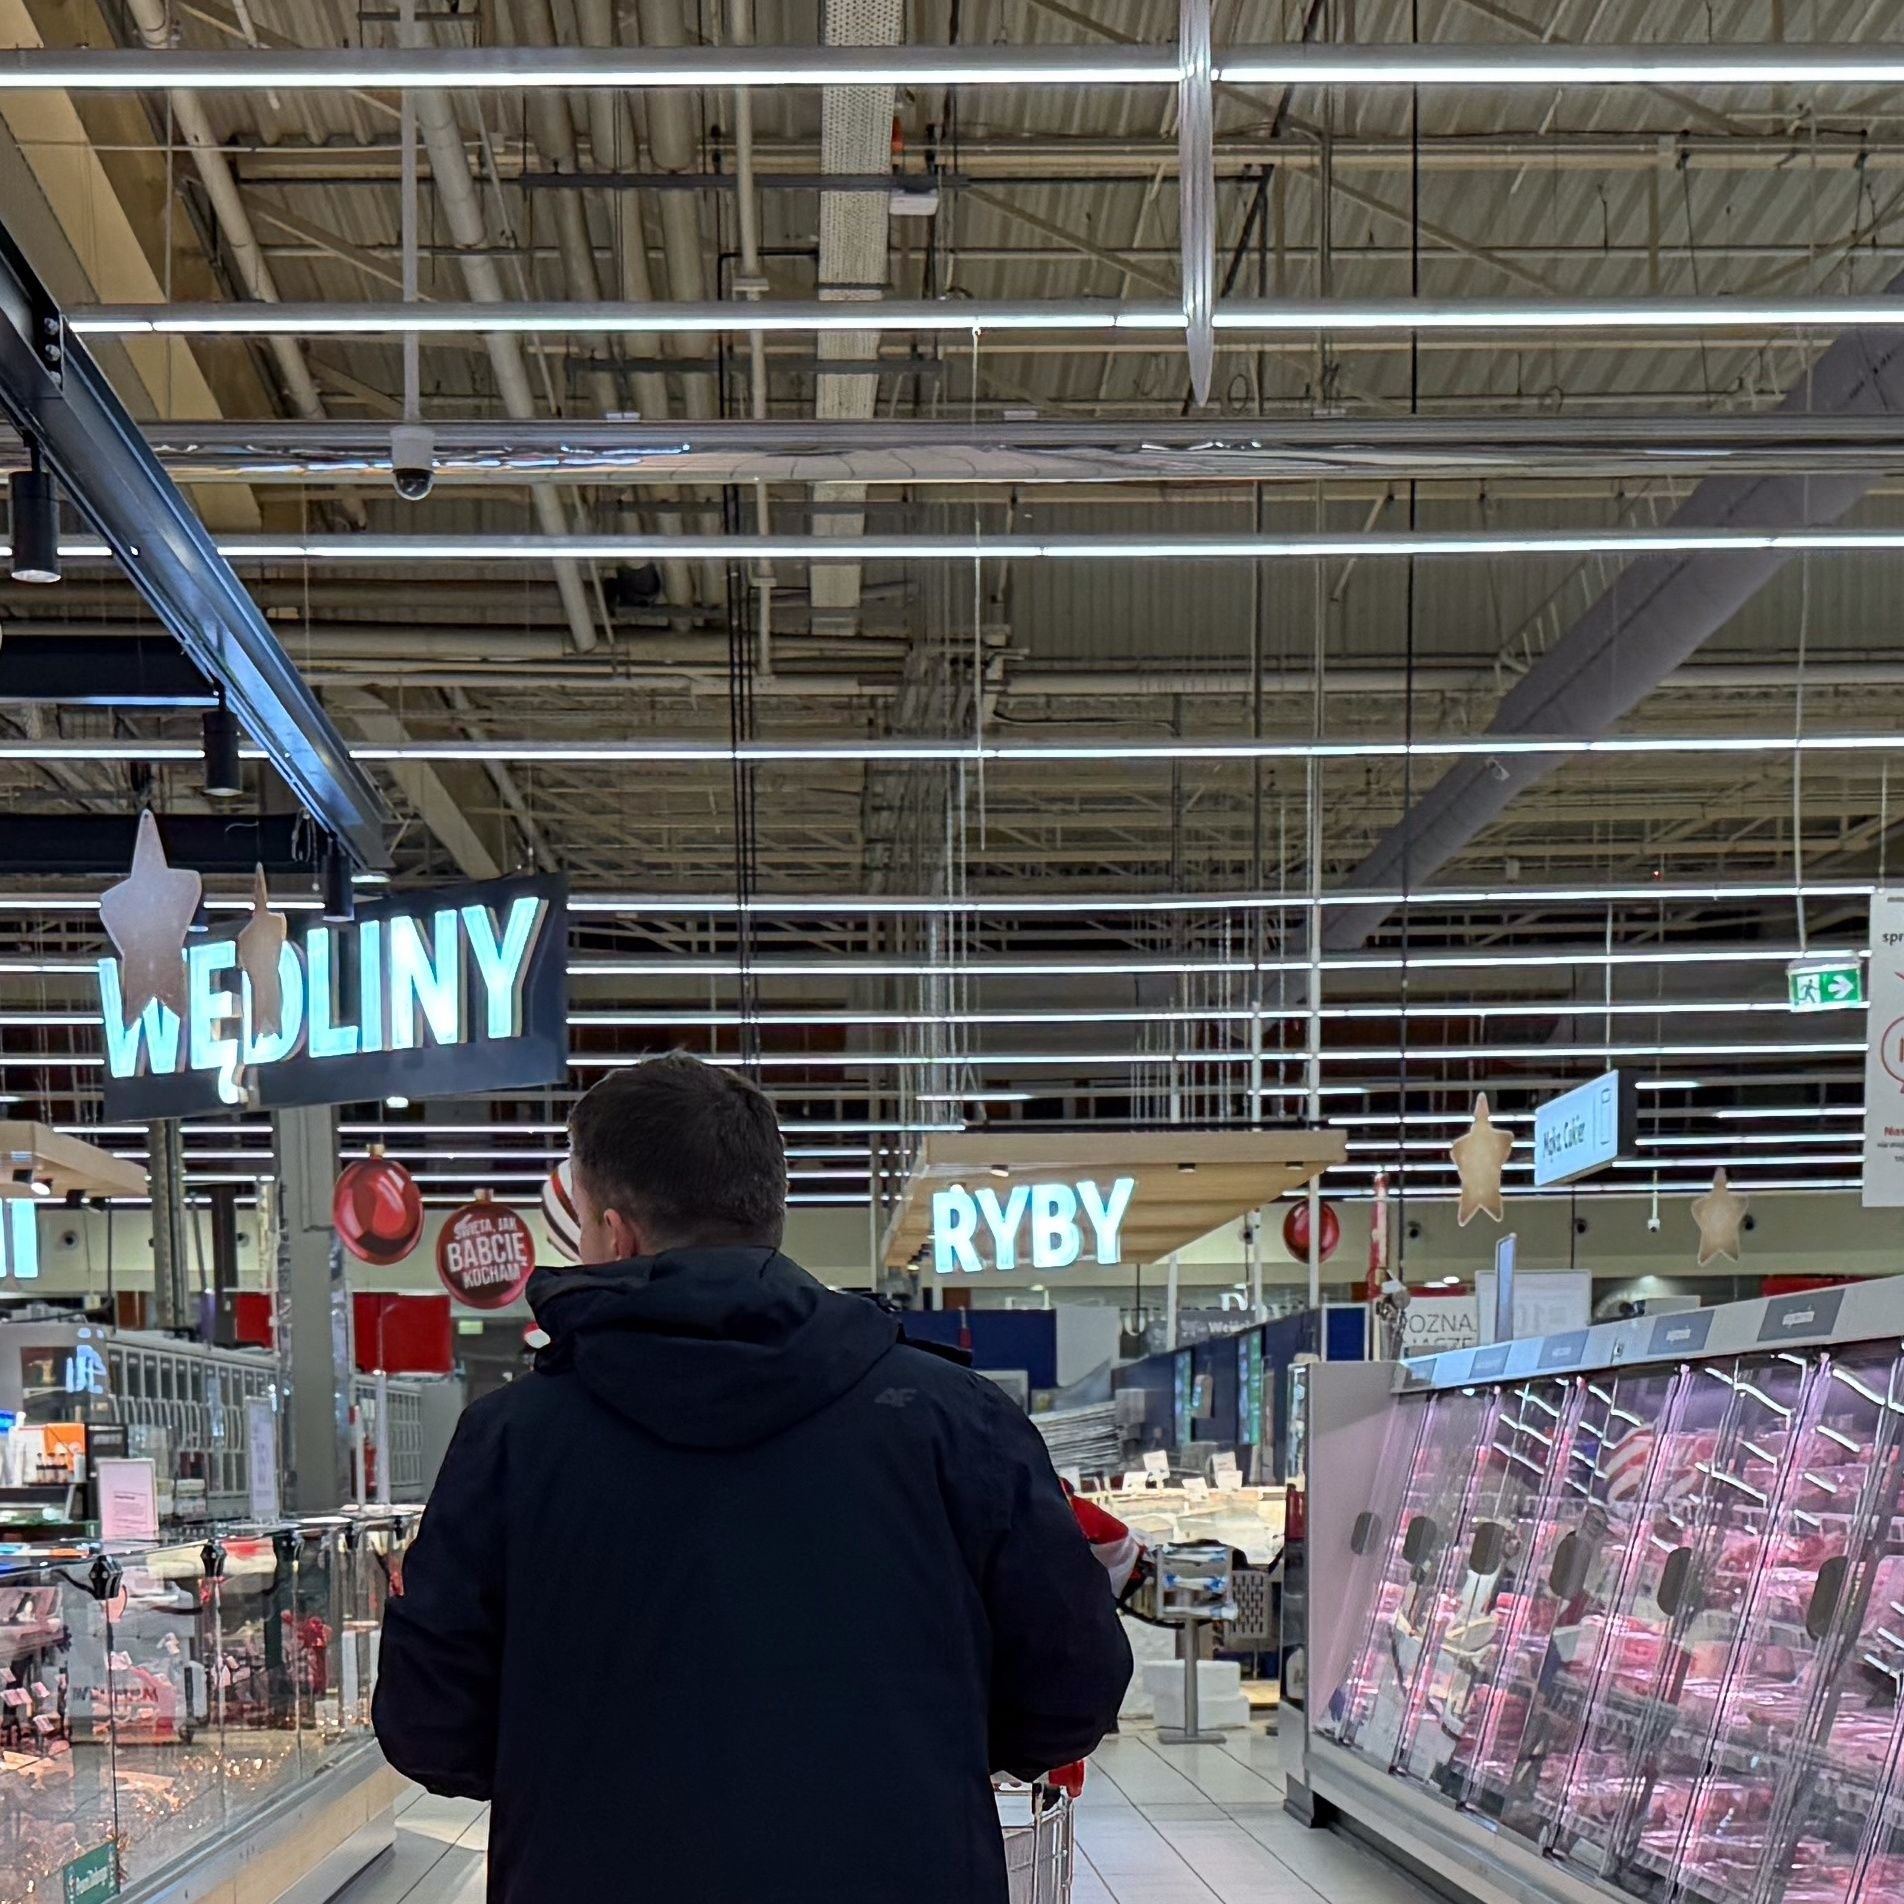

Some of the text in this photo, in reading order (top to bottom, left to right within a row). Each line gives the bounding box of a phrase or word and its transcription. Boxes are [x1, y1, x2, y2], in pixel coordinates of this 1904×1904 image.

[97, 896, 544, 1104] WĘDLINY
[932, 1177, 1135, 1274] RYBY
[447, 1232, 528, 1273] BABCIĘ
[462, 1263, 521, 1290] KOCHAM
[1402, 1314, 1477, 1334] OZNA
